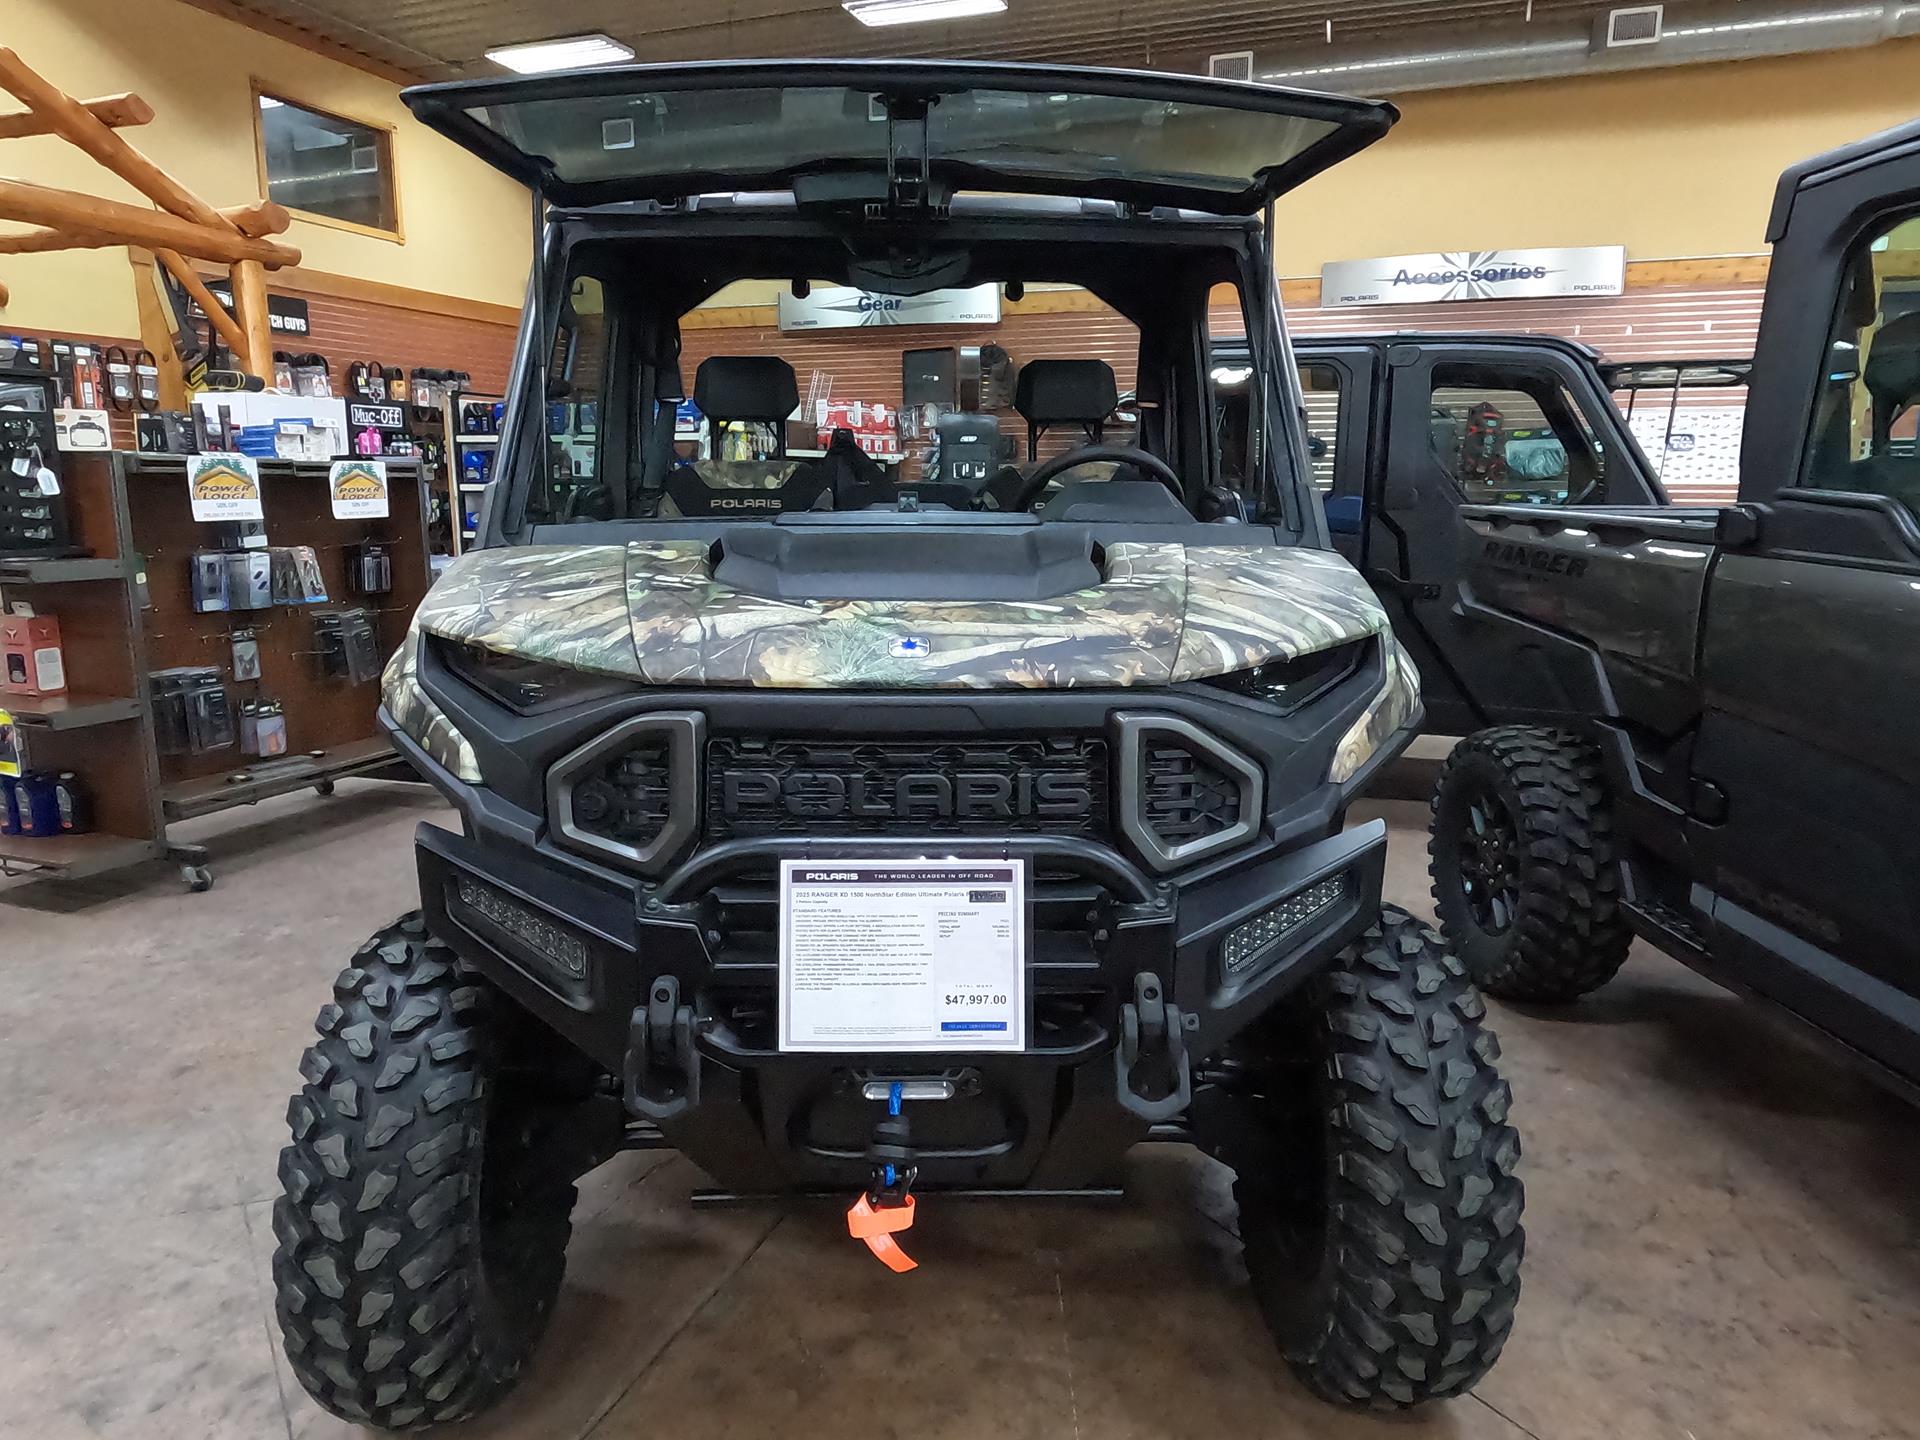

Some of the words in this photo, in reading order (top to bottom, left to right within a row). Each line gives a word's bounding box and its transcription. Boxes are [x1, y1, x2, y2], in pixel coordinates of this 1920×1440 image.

[1392, 262, 1547, 287] Accessories
[1573, 284, 1617, 292] POLARIS
[857, 296, 902, 313] Gear
[1340, 294, 1379, 303] POLARIS
[284, 316, 307, 332] GUYS
[353, 408, 400, 425] Muc-Off
[199, 485, 250, 493] POWER
[202, 492, 249, 500] LODGE
[710, 498, 783, 509] POLARIS
[1482, 540, 1590, 578] RANGER
[723, 771, 1093, 817] POLARIS
[805, 872, 859, 881] POLARIS
[945, 994, 1007, 1006] $47,997.00
